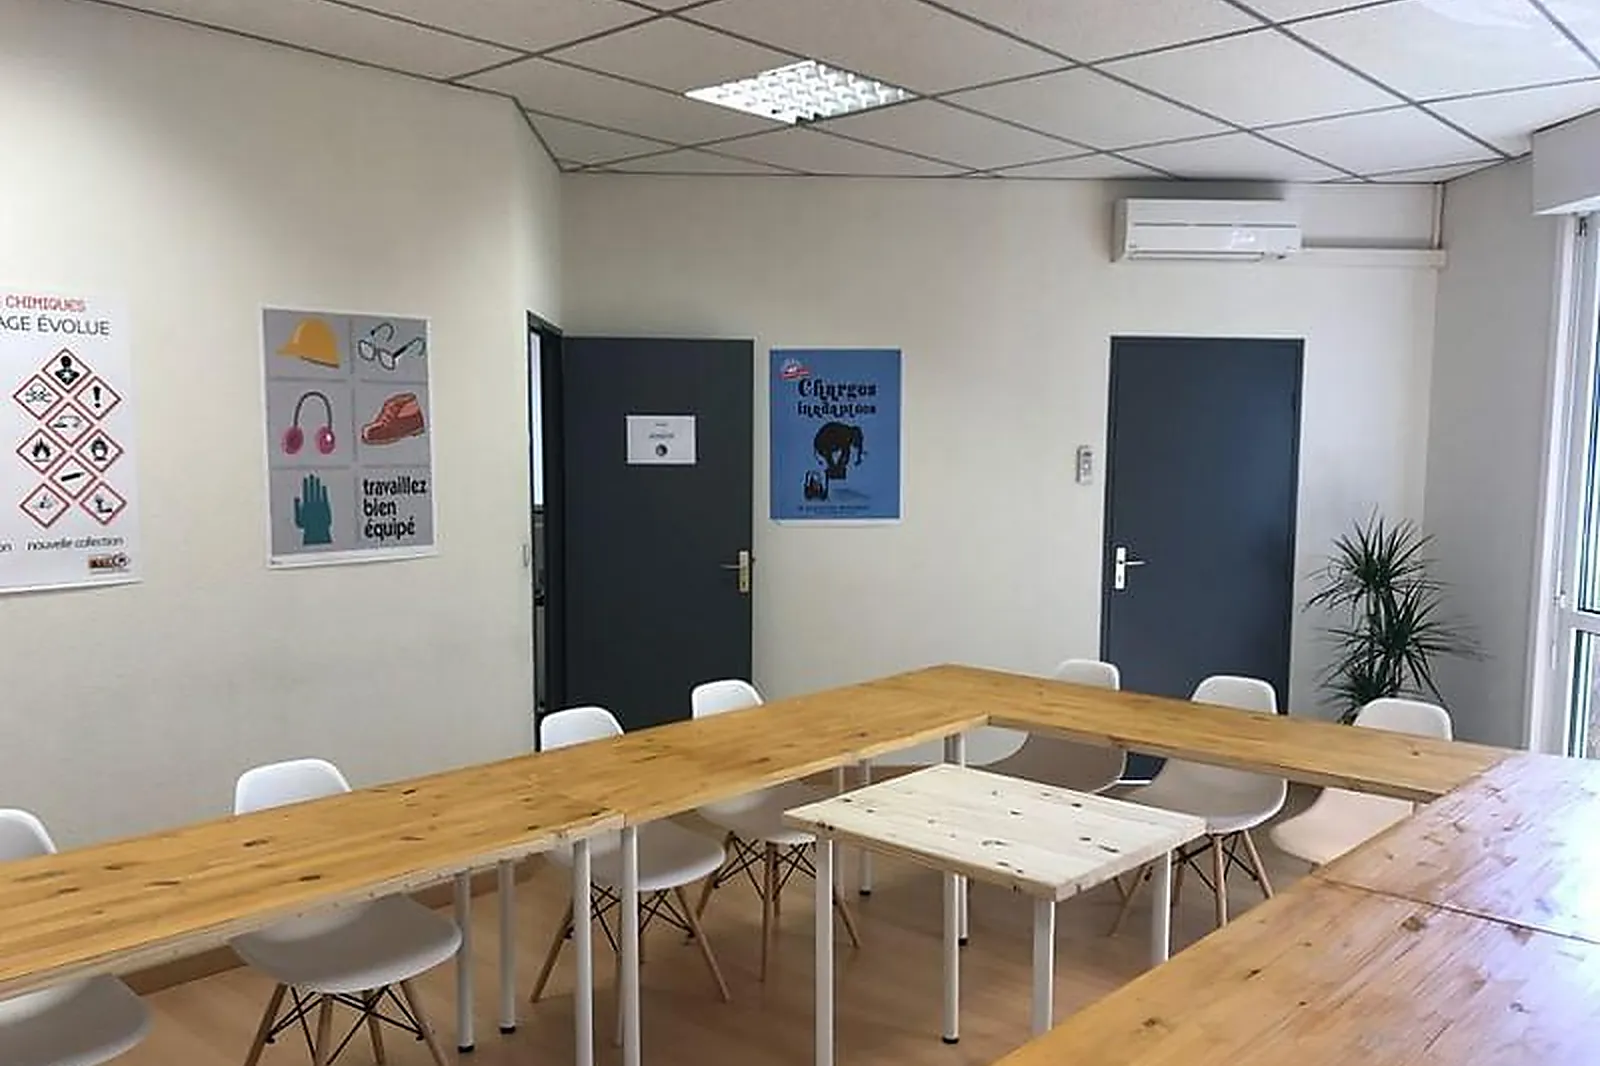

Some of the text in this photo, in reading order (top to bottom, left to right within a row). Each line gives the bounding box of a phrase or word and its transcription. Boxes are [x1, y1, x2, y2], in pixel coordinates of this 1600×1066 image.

[5, 295, 86, 312] CHIMIQUES
[37, 314, 110, 336] ÉVOLUE
[363, 476, 427, 495] travaillez
[363, 498, 397, 516] bien
[364, 516, 416, 541] équipé
[27, 537, 73, 550] nouvelle
[75, 535, 124, 549] collection
